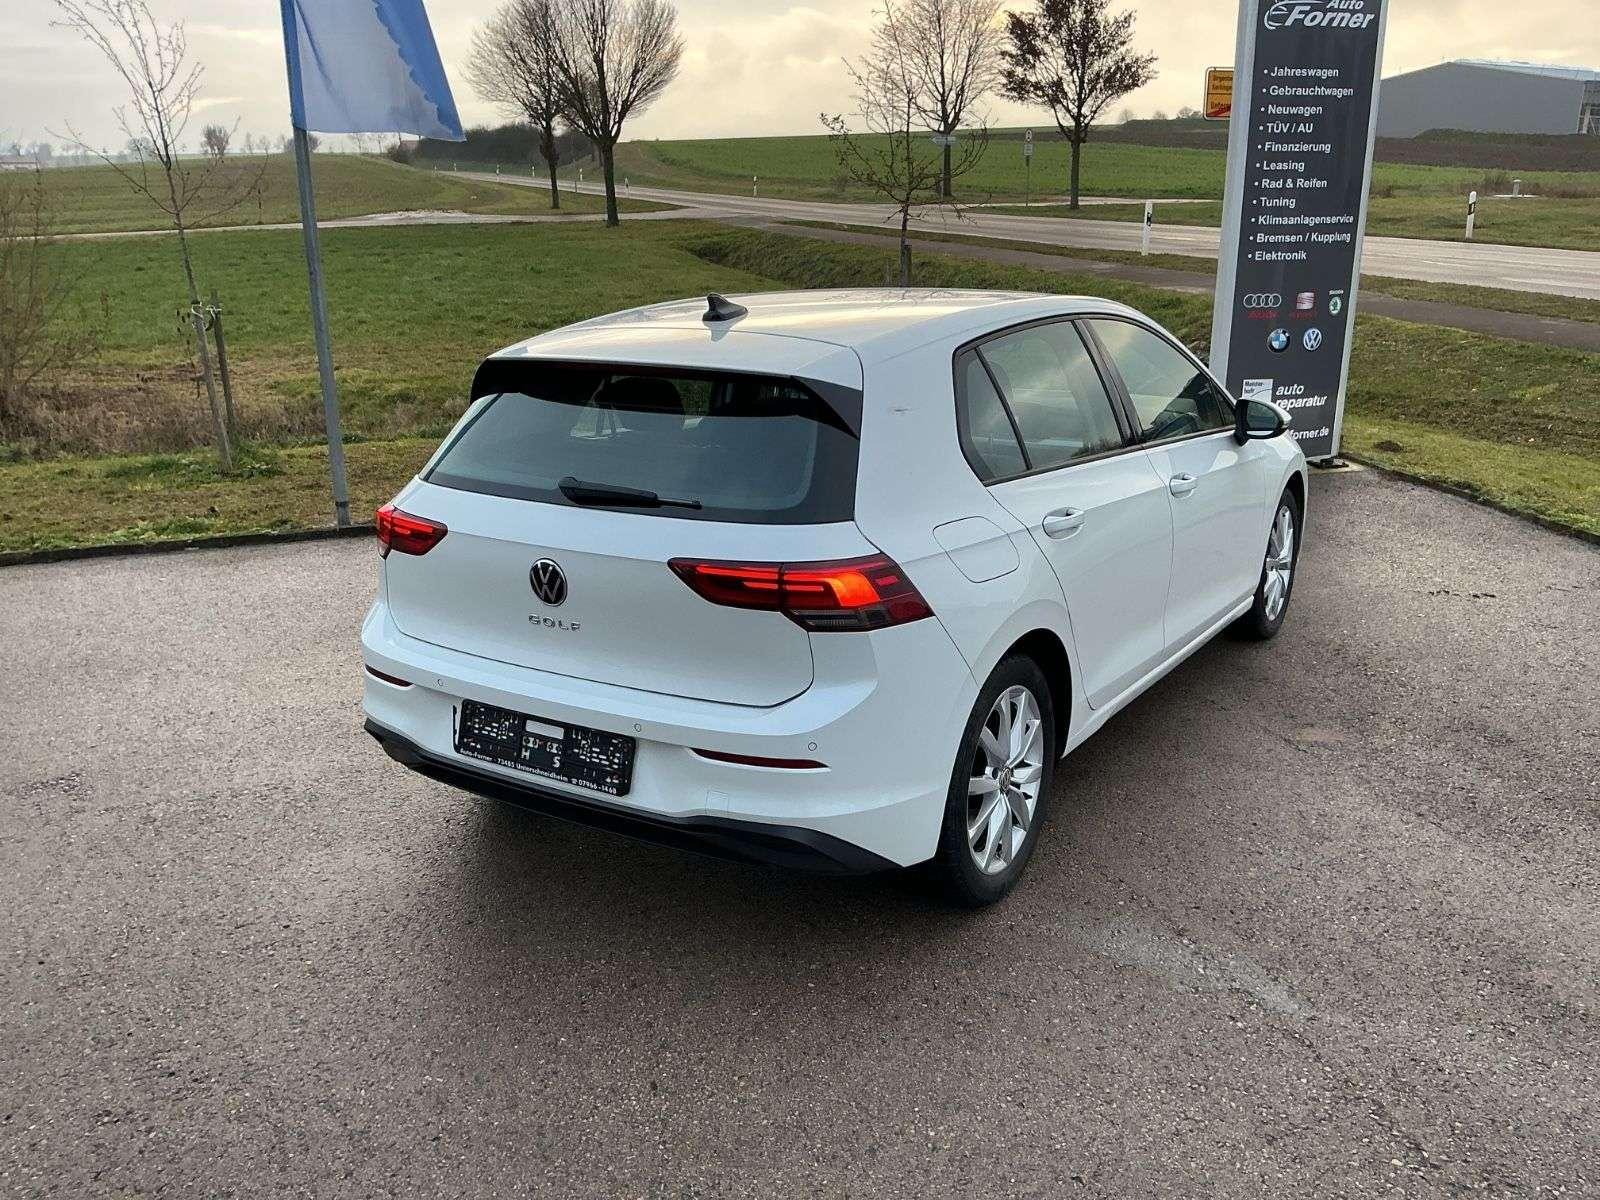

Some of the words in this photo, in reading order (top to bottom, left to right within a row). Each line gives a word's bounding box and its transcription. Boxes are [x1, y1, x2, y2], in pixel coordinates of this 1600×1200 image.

[1326, 0, 1364, 10] Auto
[1284, 5, 1375, 29] Forner
[1270, 66, 1339, 79] Jahreswagen
[1269, 85, 1354, 98] Gebrauchtwagen
[1267, 104, 1323, 117] Neuwagen
[1266, 120, 1291, 133] TÜV
[1297, 123, 1314, 133] AU
[1264, 141, 1332, 154] Finanzierung
[1262, 160, 1305, 172] Leasing
[1261, 178, 1283, 189] Rad
[1285, 178, 1294, 188] &
[1296, 177, 1328, 188] Reifen
[1260, 196, 1296, 209] Tuning
[1258, 214, 1354, 226] Klimaanlagenservice
[1256, 232, 1303, 243] Bremsen
[1310, 231, 1351, 244] Kupplung
[1254, 251, 1307, 261] Elektronik
[1276, 384, 1305, 396] auto
[1275, 395, 1328, 411] reparatur
[528, 613, 581, 632] GOLF
